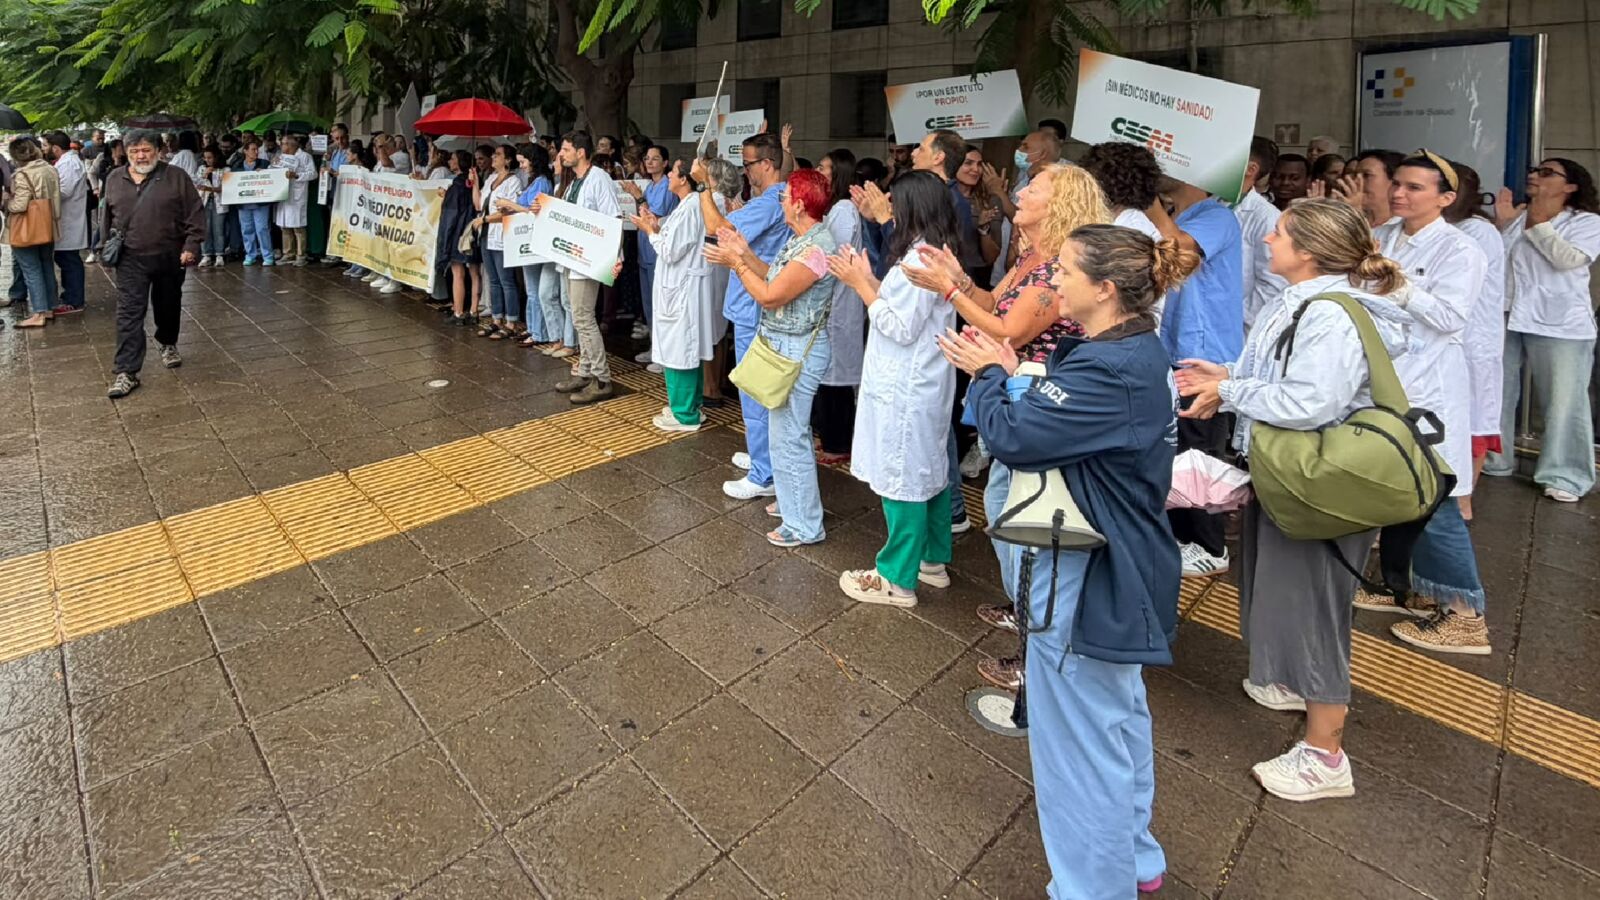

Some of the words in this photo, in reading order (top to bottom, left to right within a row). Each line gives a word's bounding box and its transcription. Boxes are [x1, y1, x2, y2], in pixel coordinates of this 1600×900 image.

[934, 88, 944, 97] UN
[946, 83, 984, 95] ESTATUTO
[934, 95, 968, 106] PROPIO!
[1119, 81, 1149, 102] MÉDICOS
[1149, 91, 1160, 105] NO
[1160, 94, 1176, 109] HAY
[1176, 98, 1214, 121] SANIDAD!
[925, 114, 973, 129] CESM
[1111, 117, 1174, 153] CESM
[383, 186, 413, 199] PELIGRO
